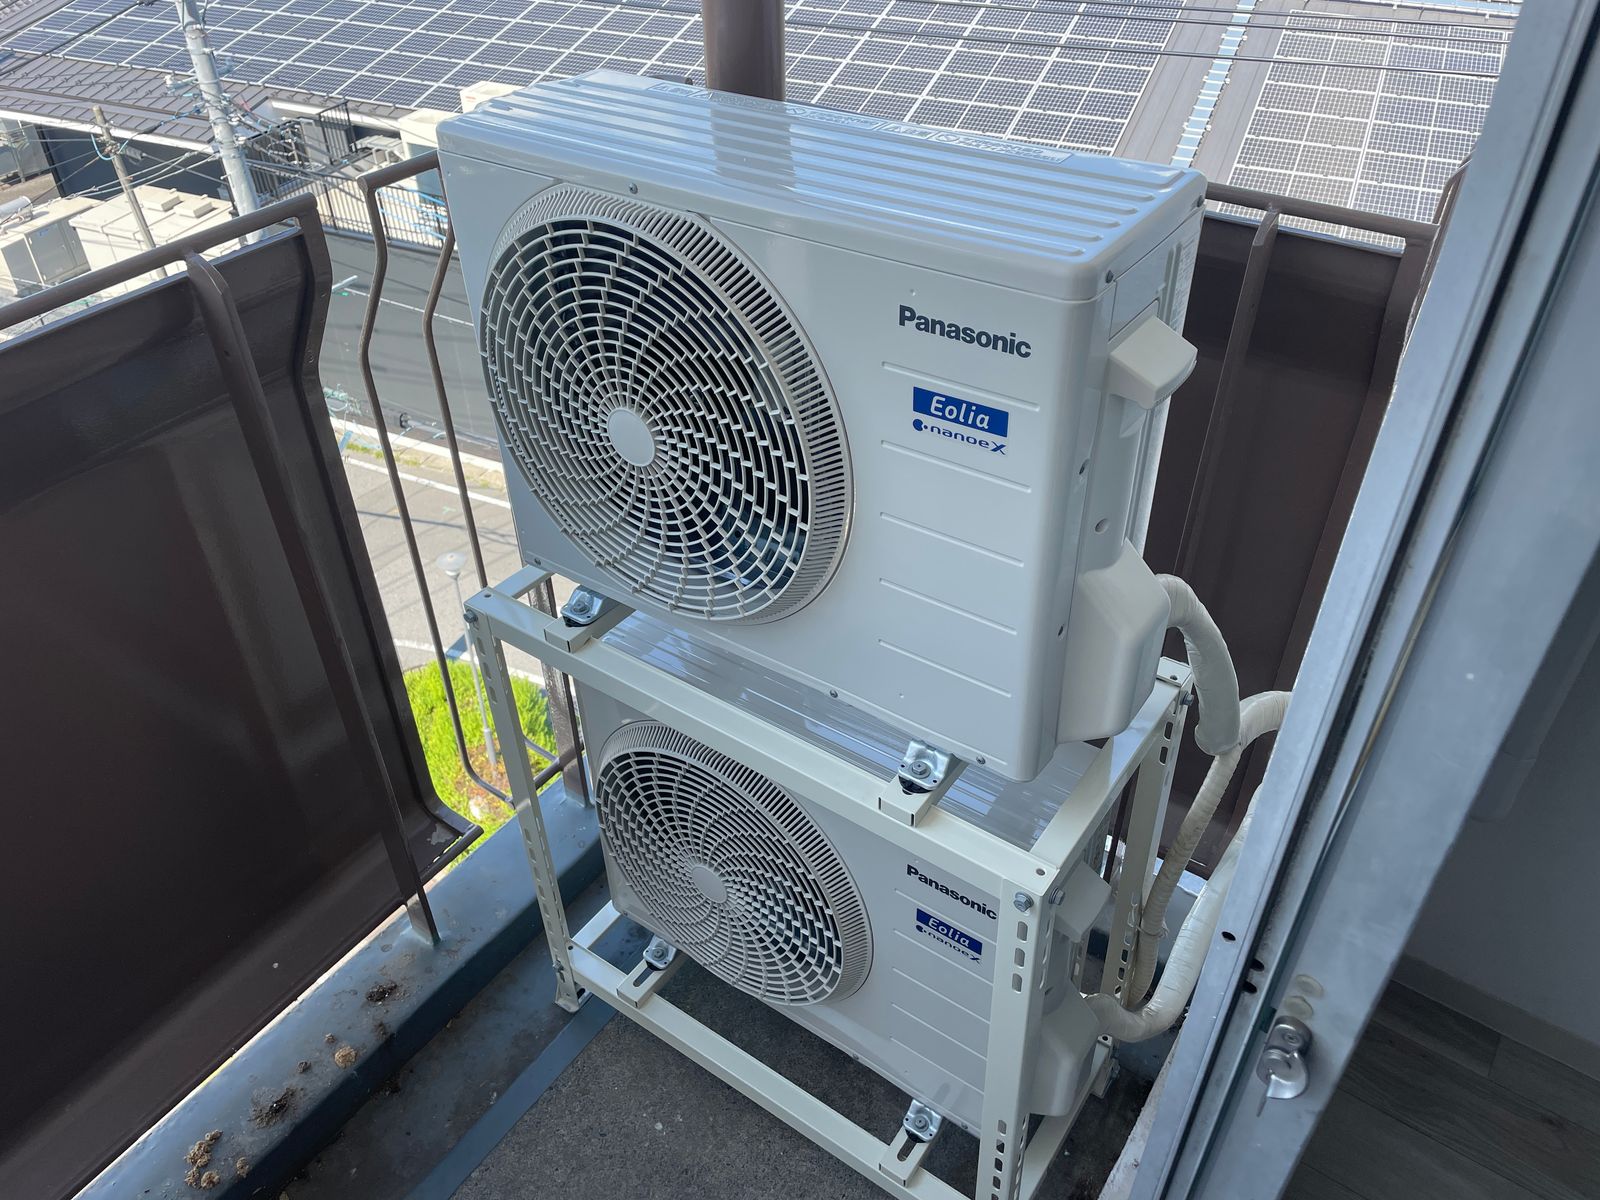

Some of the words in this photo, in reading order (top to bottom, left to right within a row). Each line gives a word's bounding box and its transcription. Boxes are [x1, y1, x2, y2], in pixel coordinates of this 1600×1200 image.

[899, 304, 1031, 358] Panasonic
[930, 396, 990, 430] Eolia
[906, 863, 998, 920] Panasonic
[928, 917, 970, 948] Eolia
